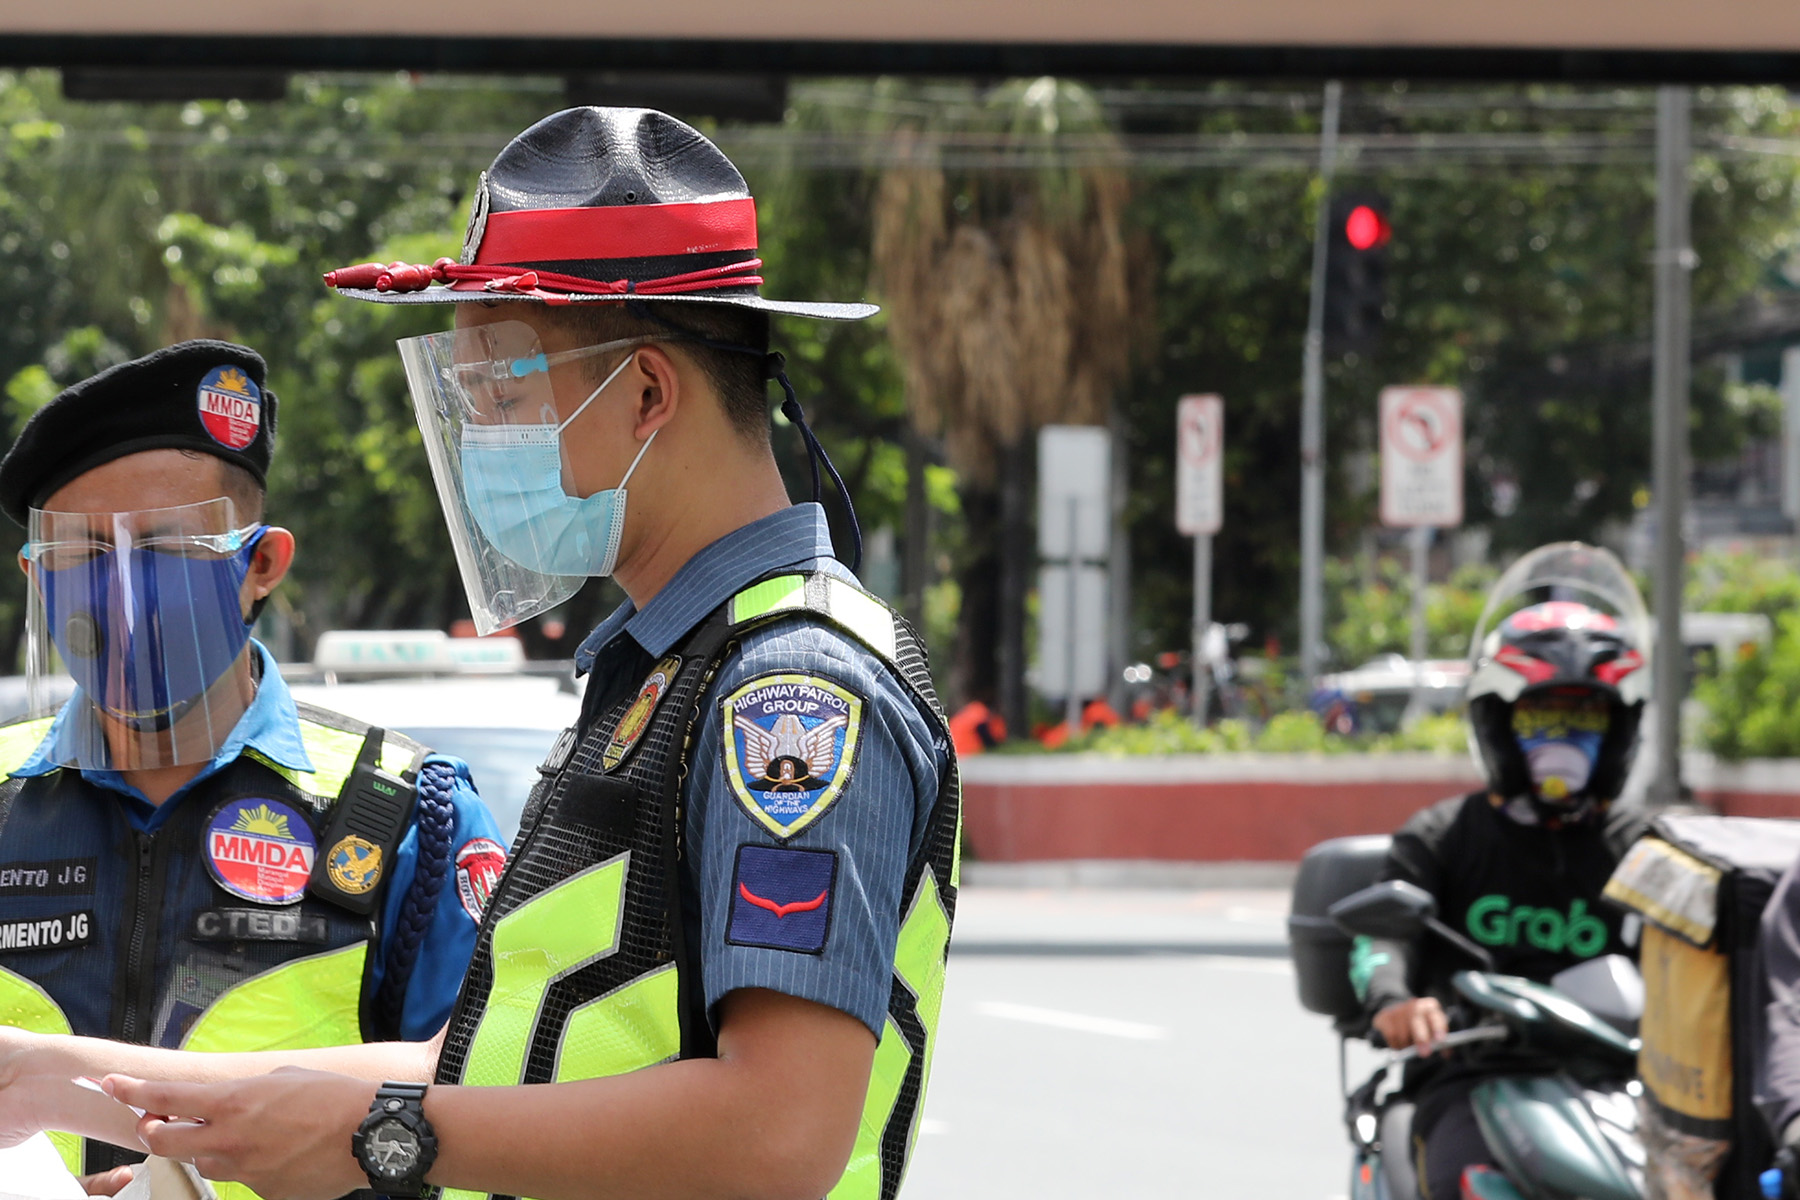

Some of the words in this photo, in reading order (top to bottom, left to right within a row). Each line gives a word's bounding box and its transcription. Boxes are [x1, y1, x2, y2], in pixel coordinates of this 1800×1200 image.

[206, 392, 256, 422] MMDA
[733, 685, 797, 713] HIGHWAY
[798, 685, 849, 714] PATROL
[762, 700, 819, 714] GROUP
[763, 791, 810, 800] GUARDIAN
[764, 804, 808, 814] HIGHWAYS
[214, 834, 309, 872] MMDA
[66, 913, 88, 941] JG
[1466, 894, 1608, 957] Grab
